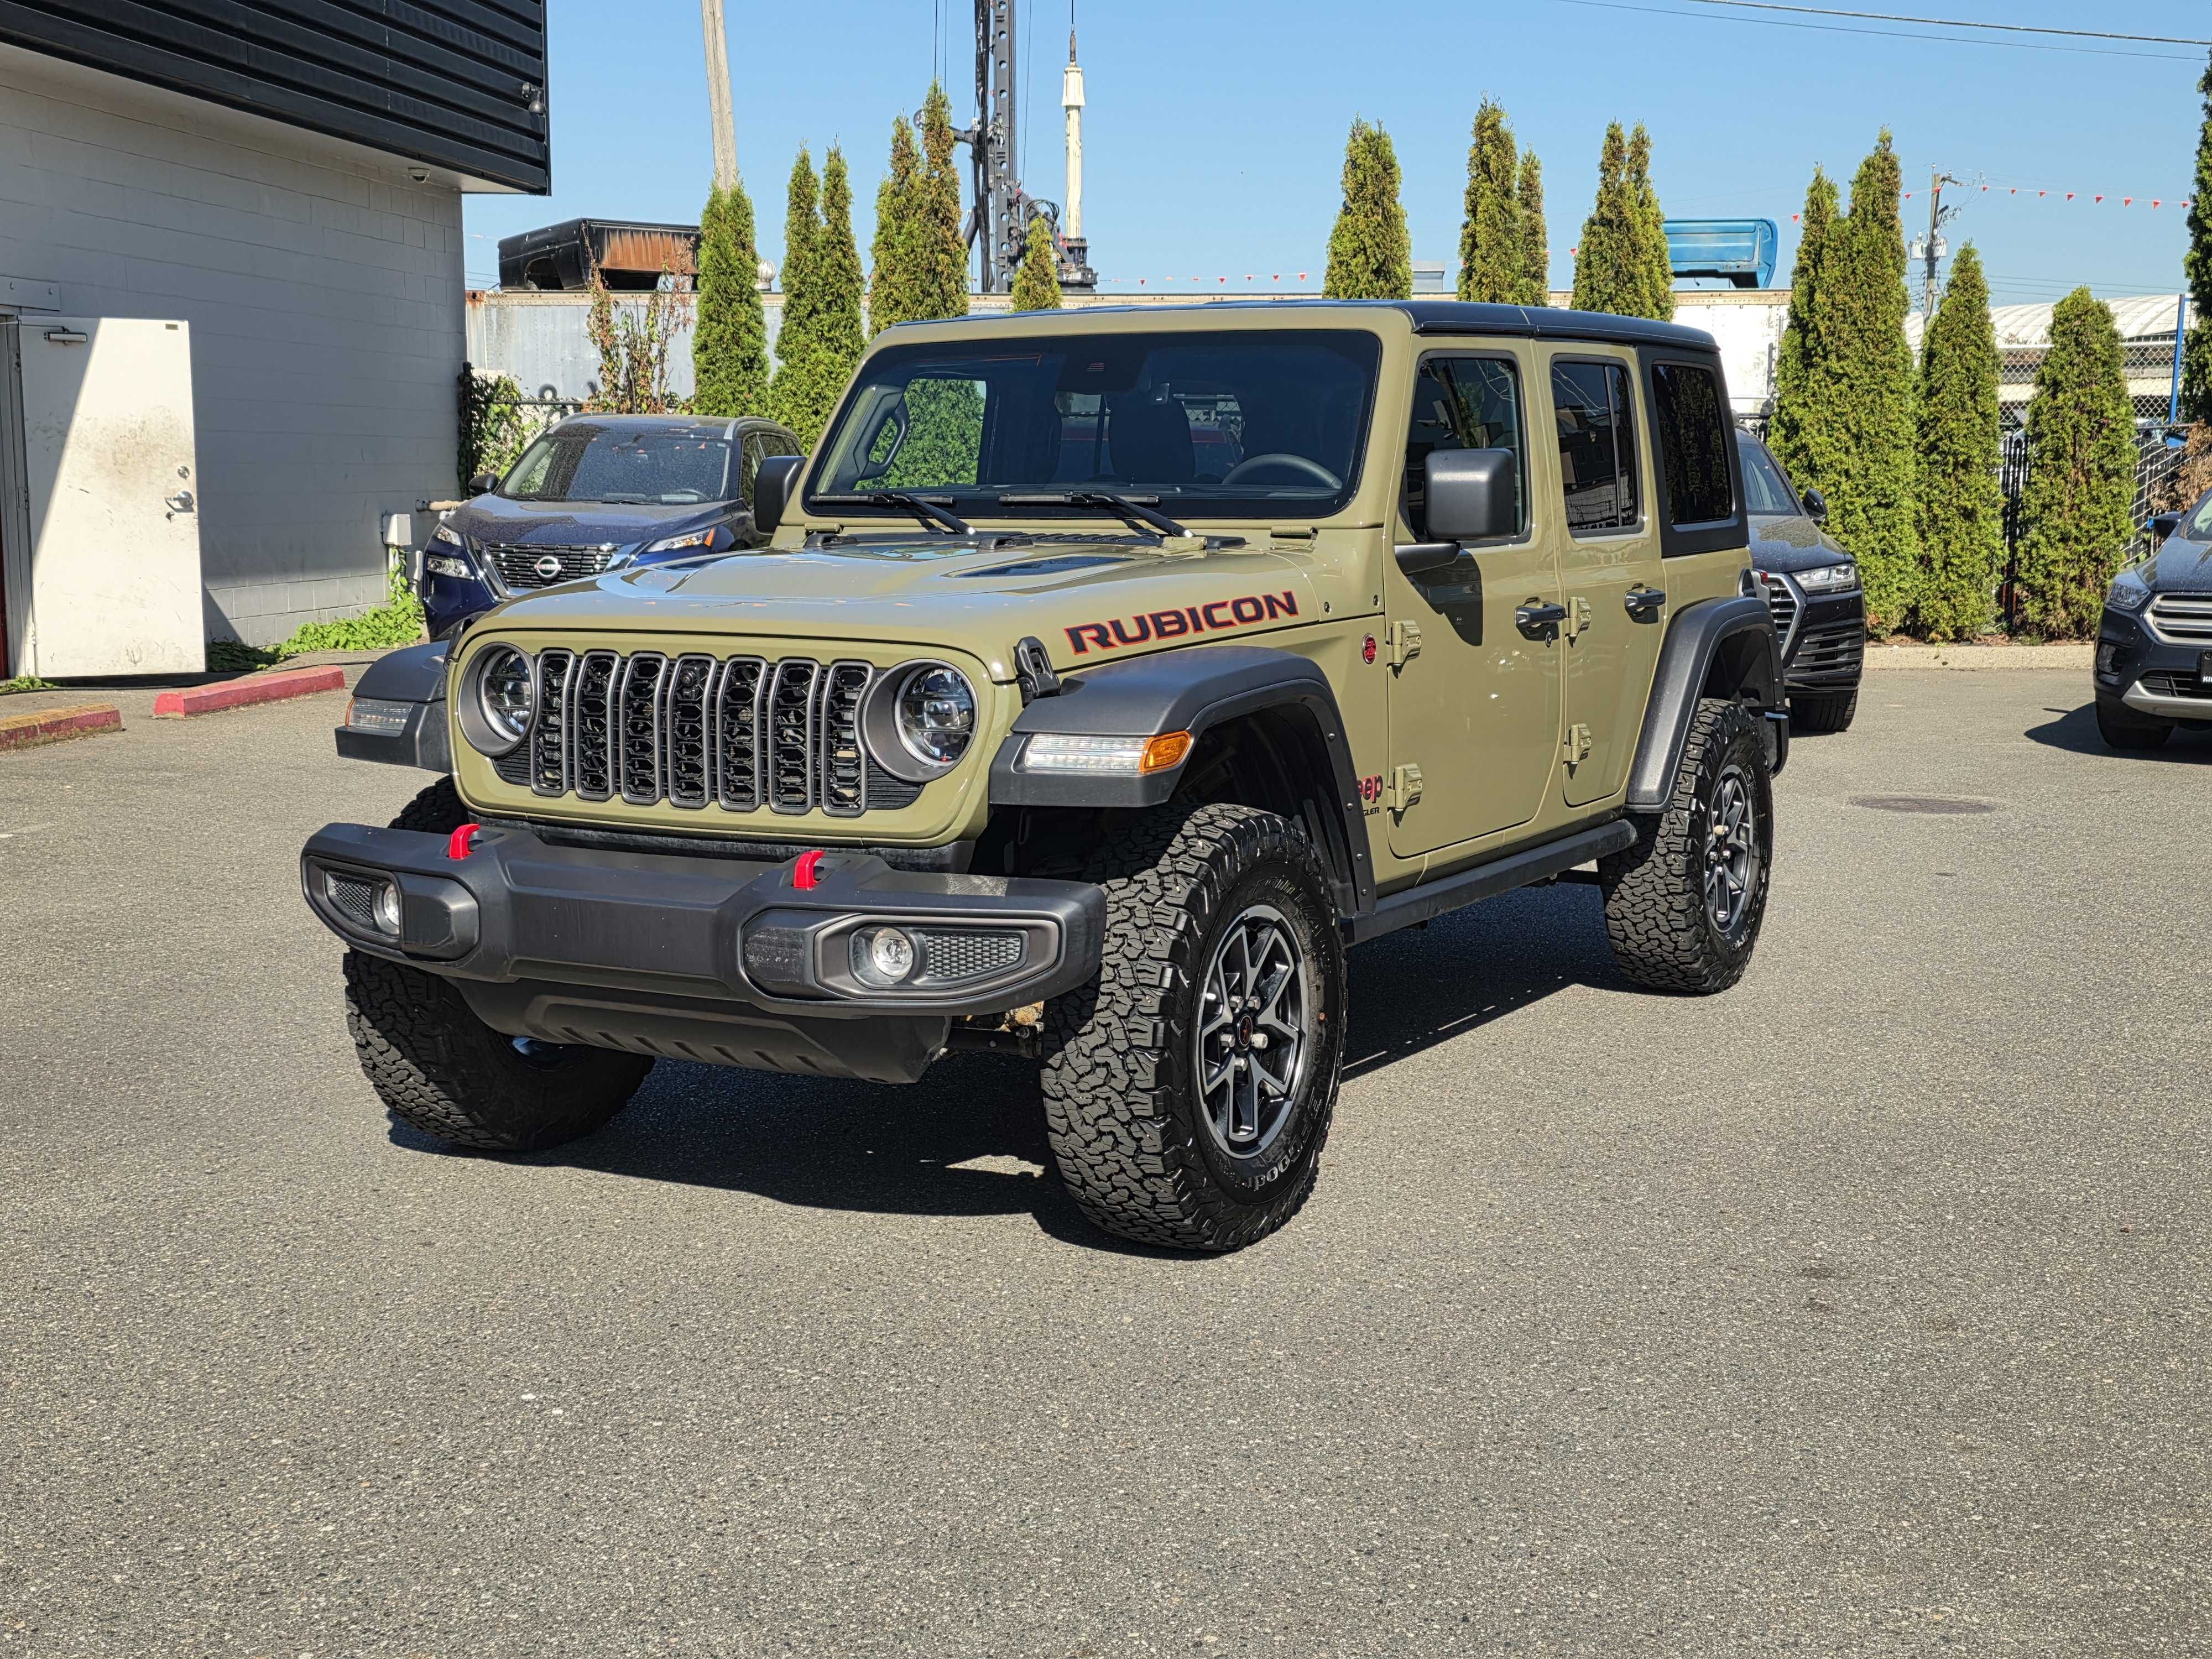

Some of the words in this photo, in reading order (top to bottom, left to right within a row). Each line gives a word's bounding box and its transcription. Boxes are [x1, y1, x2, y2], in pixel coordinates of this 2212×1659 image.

[1063, 590, 1299, 655] RUBICON
[1358, 775, 1383, 804] eep
[1363, 807, 1380, 816] GLER
